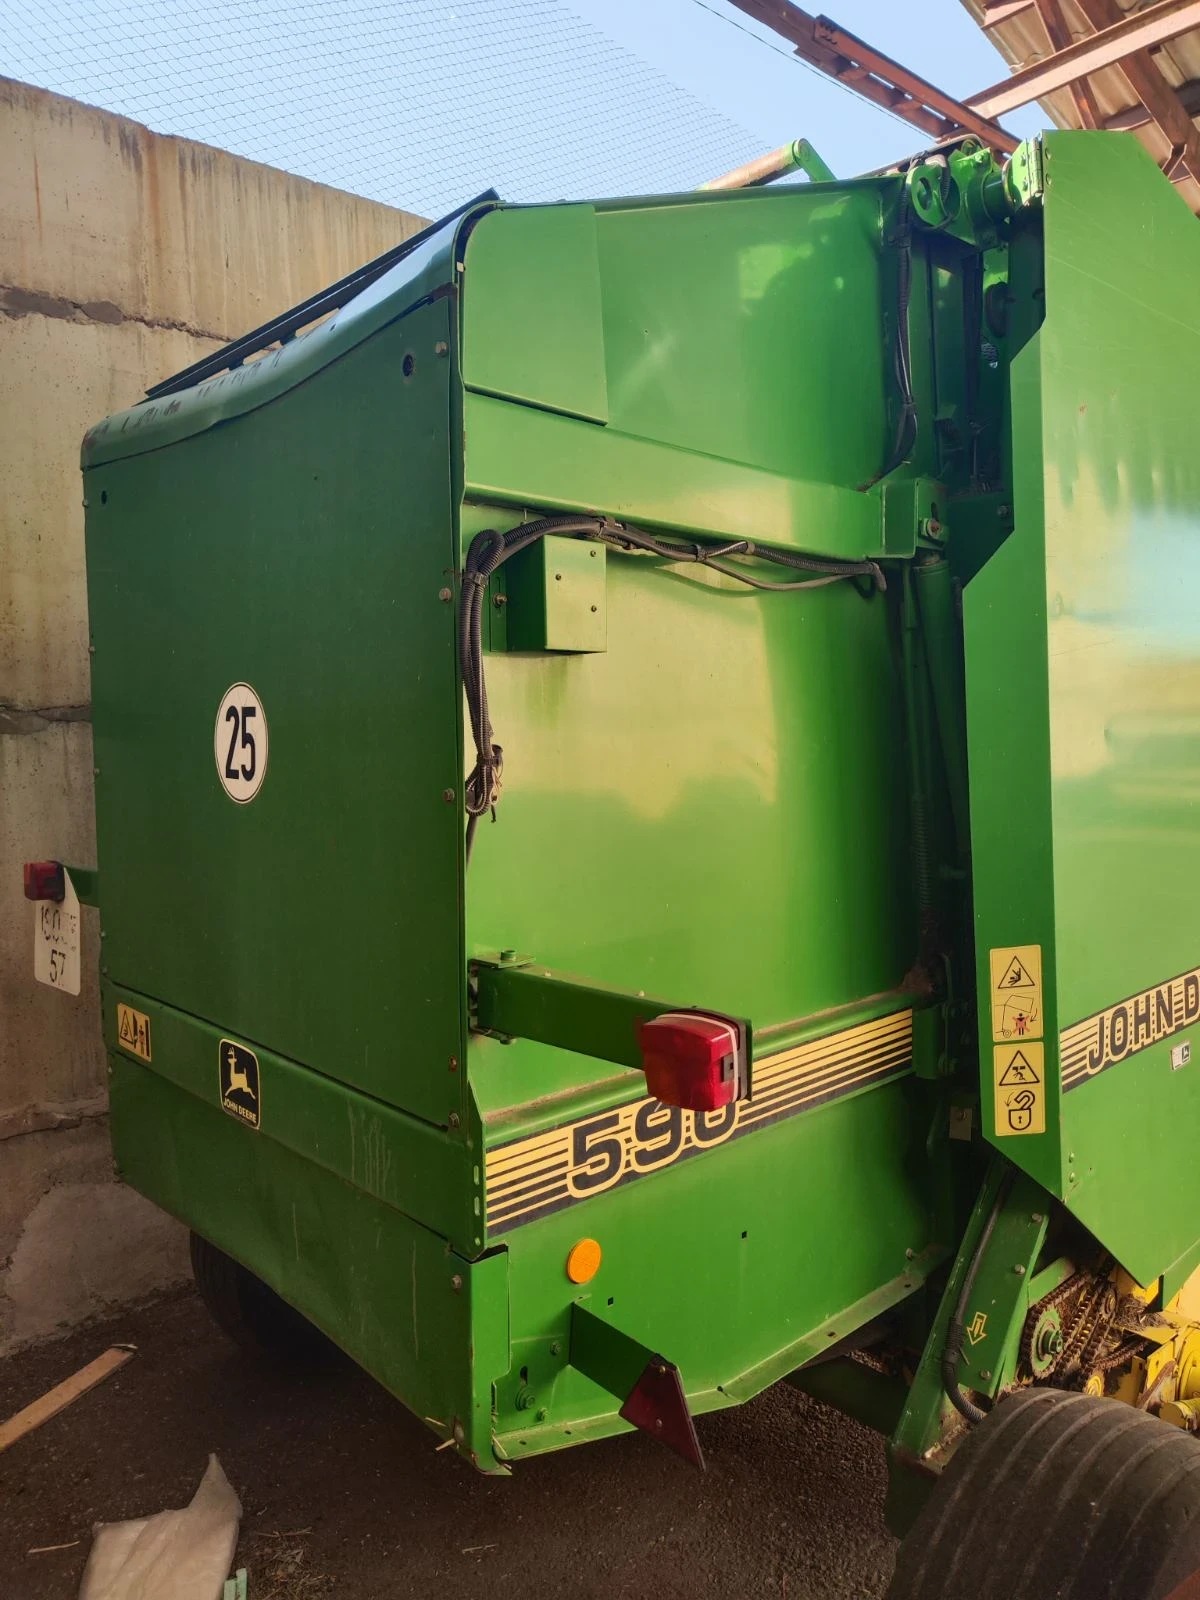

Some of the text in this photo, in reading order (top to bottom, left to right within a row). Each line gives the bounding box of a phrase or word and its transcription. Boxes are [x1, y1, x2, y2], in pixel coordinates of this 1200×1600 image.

[225, 705, 256, 782] 25
[1088, 983, 1174, 1070] JOHN
[223, 1097, 257, 1123] JOHN DEERE
